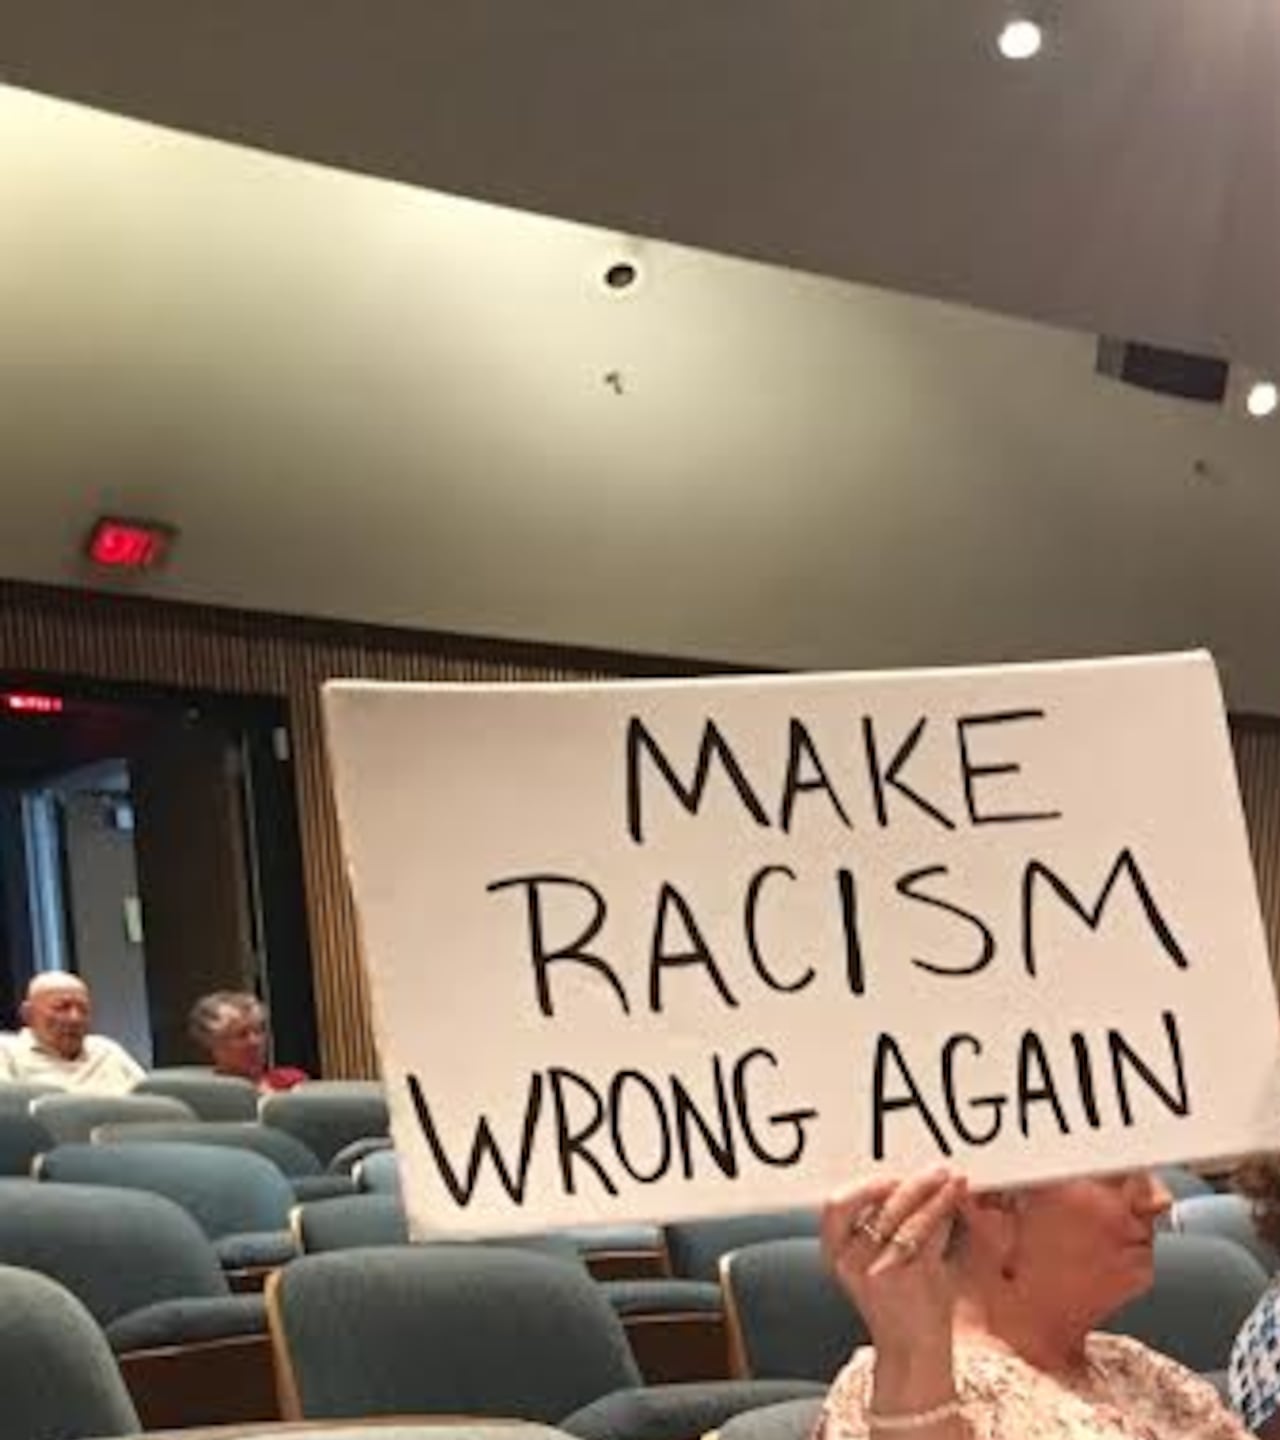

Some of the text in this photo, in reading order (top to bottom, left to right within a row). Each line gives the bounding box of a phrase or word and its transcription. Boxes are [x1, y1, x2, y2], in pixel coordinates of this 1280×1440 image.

[626, 709, 1062, 844] MAKE
[485, 848, 1189, 1018] RACISM
[406, 1011, 1191, 1207] WRONG AGAIN
